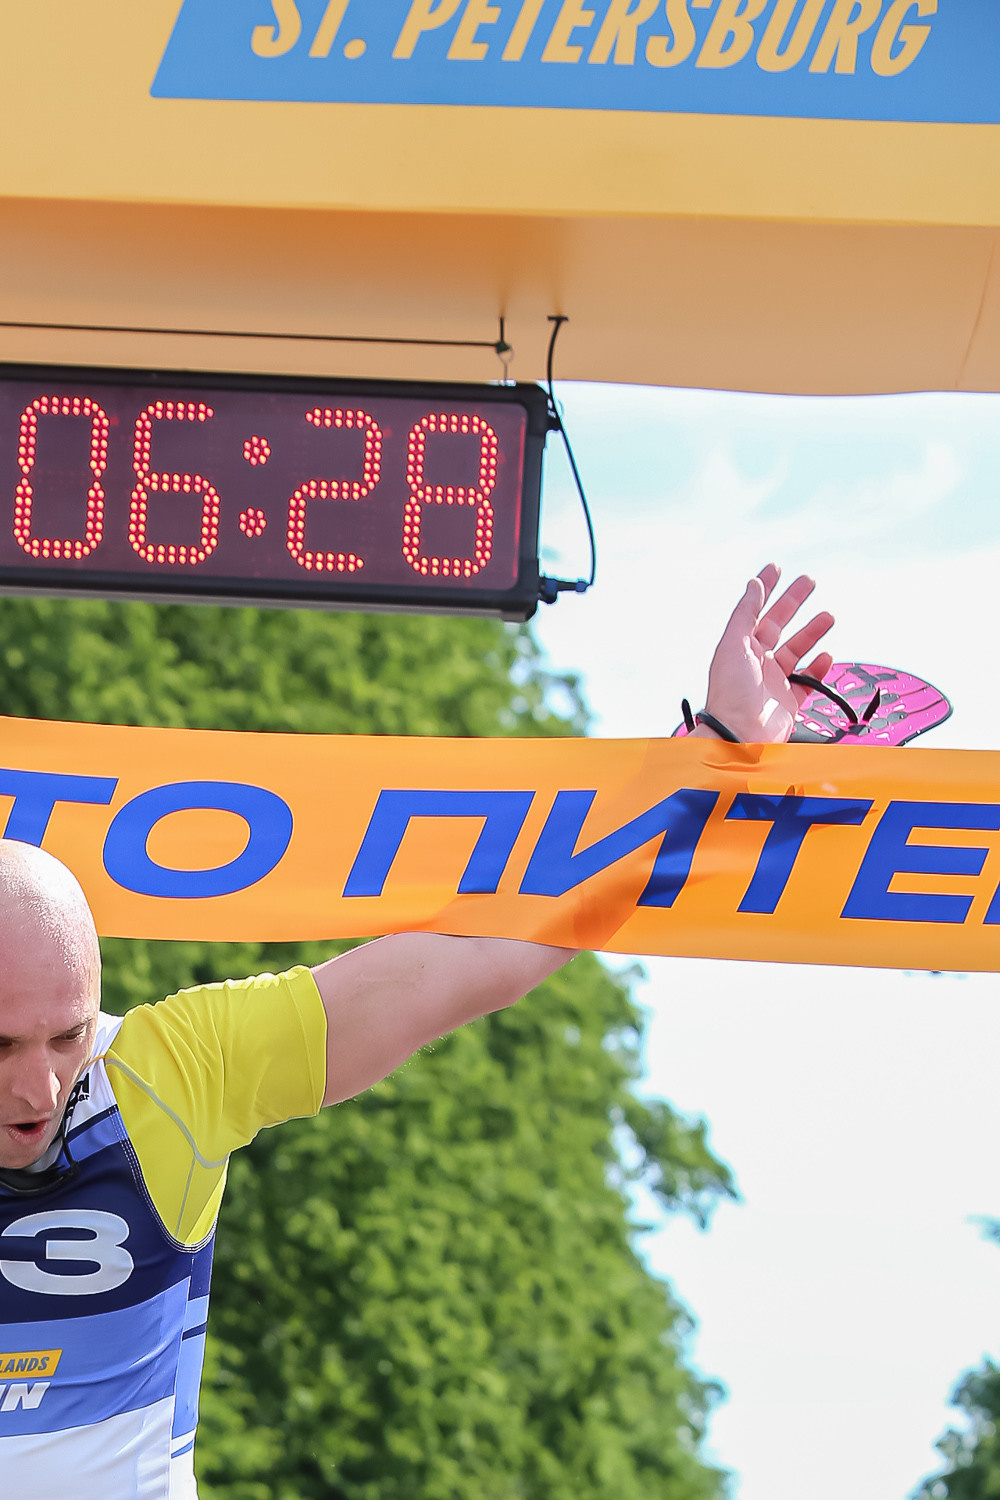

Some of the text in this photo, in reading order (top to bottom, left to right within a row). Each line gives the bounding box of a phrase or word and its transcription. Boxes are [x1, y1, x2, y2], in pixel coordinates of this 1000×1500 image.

[251, 0, 938, 76] ST. PETERSBURG
[342, 788, 1000, 926] ПИТЕ
